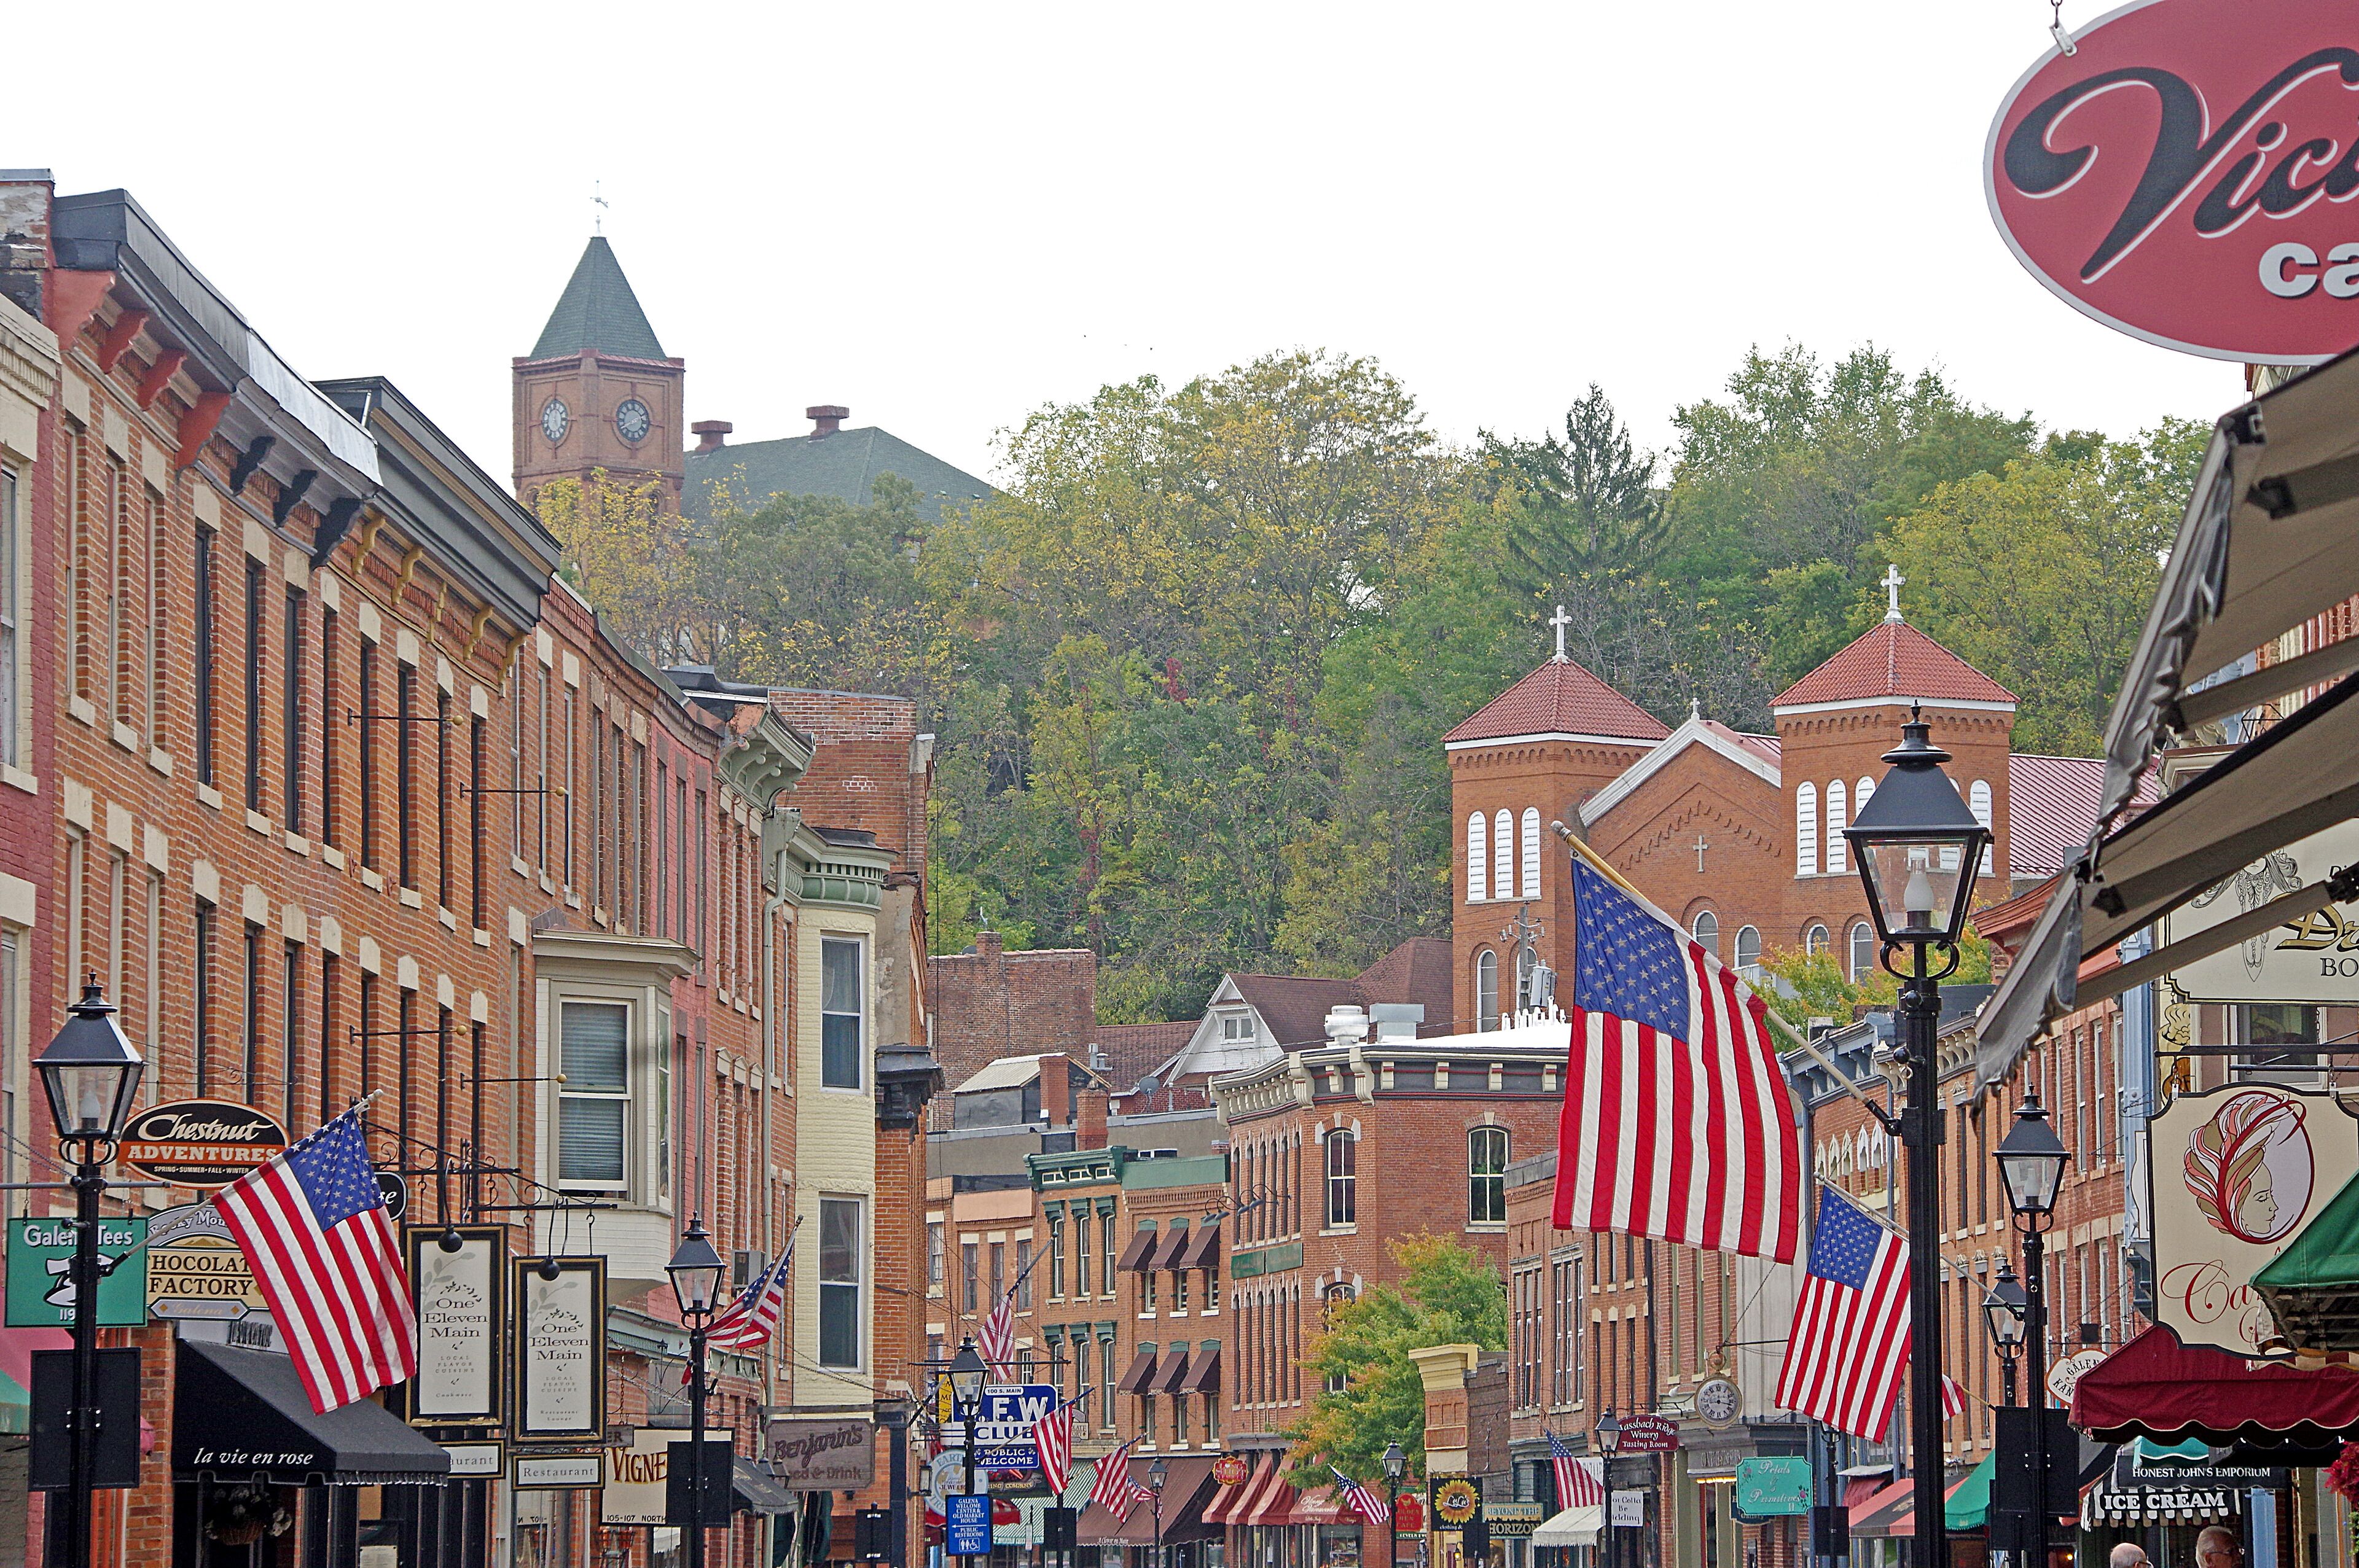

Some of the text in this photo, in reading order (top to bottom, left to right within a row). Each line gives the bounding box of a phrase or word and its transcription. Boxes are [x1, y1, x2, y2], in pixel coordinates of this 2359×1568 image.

[138, 1114, 274, 1141] Chestnut
[128, 1145, 276, 1161] ADVENTURES
[23, 1225, 133, 1246] Galen Tees
[149, 1277, 253, 1295] FACTORY
[171, 1303, 223, 1315] Galena
[436, 1298, 475, 1308] One
[423, 1313, 488, 1323] Eleven
[429, 1327, 480, 1338] Main
[542, 1323, 577, 1333] One
[529, 1337, 589, 1347] Eleven
[536, 1350, 582, 1360] Main
[1619, 1417, 1675, 1436] assbach Ridge
[975, 1427, 1035, 1440] CLUB
[1630, 1430, 1659, 1441] Winery
[773, 1424, 863, 1468] Benjamin's
[194, 1448, 314, 1465] la vie en rose
[523, 1467, 595, 1477] Restaurant
[826, 1466, 862, 1480] Drink
[1758, 1460, 1790, 1475] Petals
[2133, 1467, 2271, 1478] HONEST JOHN'S EMPORIUM
[1443, 1495, 1469, 1507] LuLu's
[2104, 1492, 2226, 1510] ICE CREAM
[1613, 1514, 1640, 1524] idding
